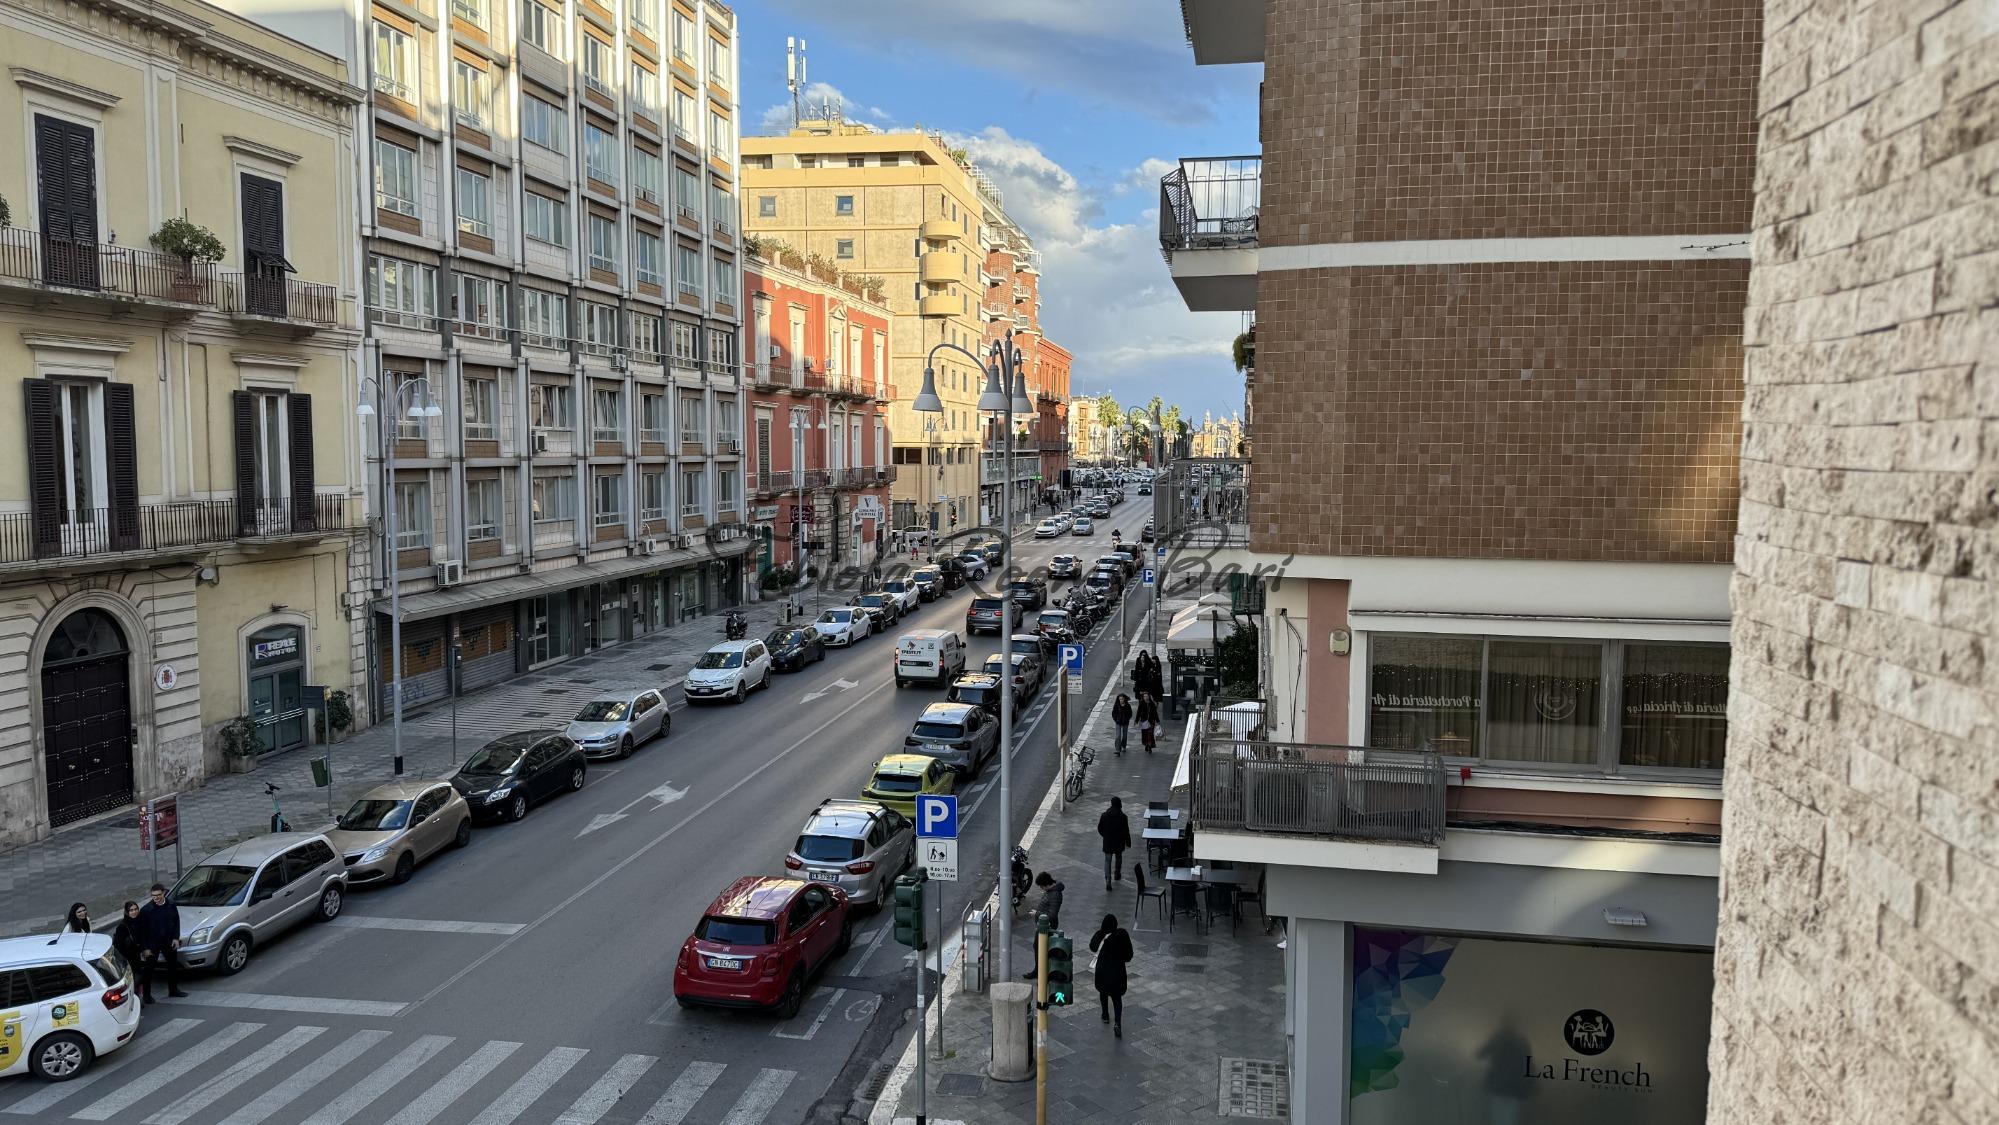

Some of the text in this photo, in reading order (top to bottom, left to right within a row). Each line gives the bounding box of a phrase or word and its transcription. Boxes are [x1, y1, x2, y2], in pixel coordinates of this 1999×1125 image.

[1145, 570, 1154, 582] P
[1062, 646, 1078, 667] P
[924, 799, 949, 833] P
[1523, 1055, 1652, 1088] La French
